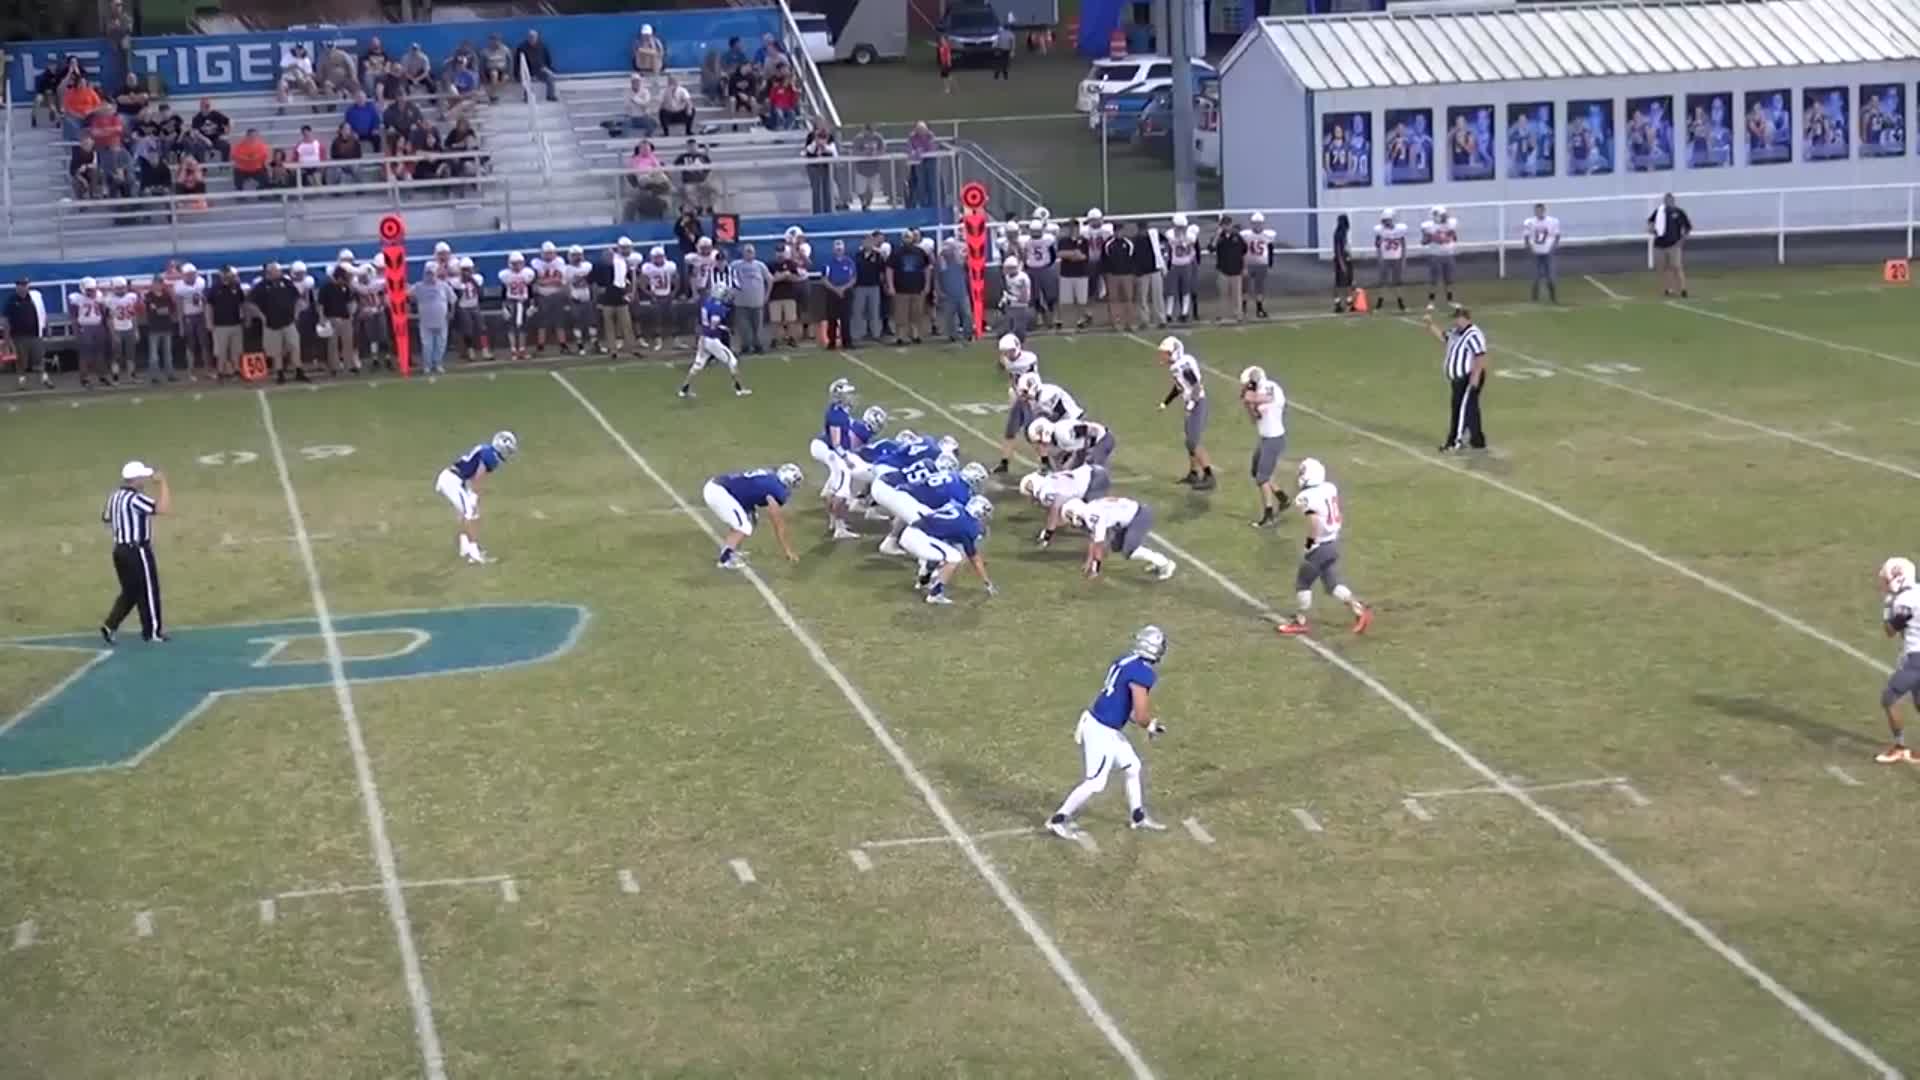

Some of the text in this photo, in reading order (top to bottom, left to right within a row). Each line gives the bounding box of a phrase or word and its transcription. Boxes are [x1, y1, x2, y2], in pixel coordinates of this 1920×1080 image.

[134, 37, 357, 86] TIGE
[717, 217, 736, 241] 3
[246, 356, 266, 376] 50
